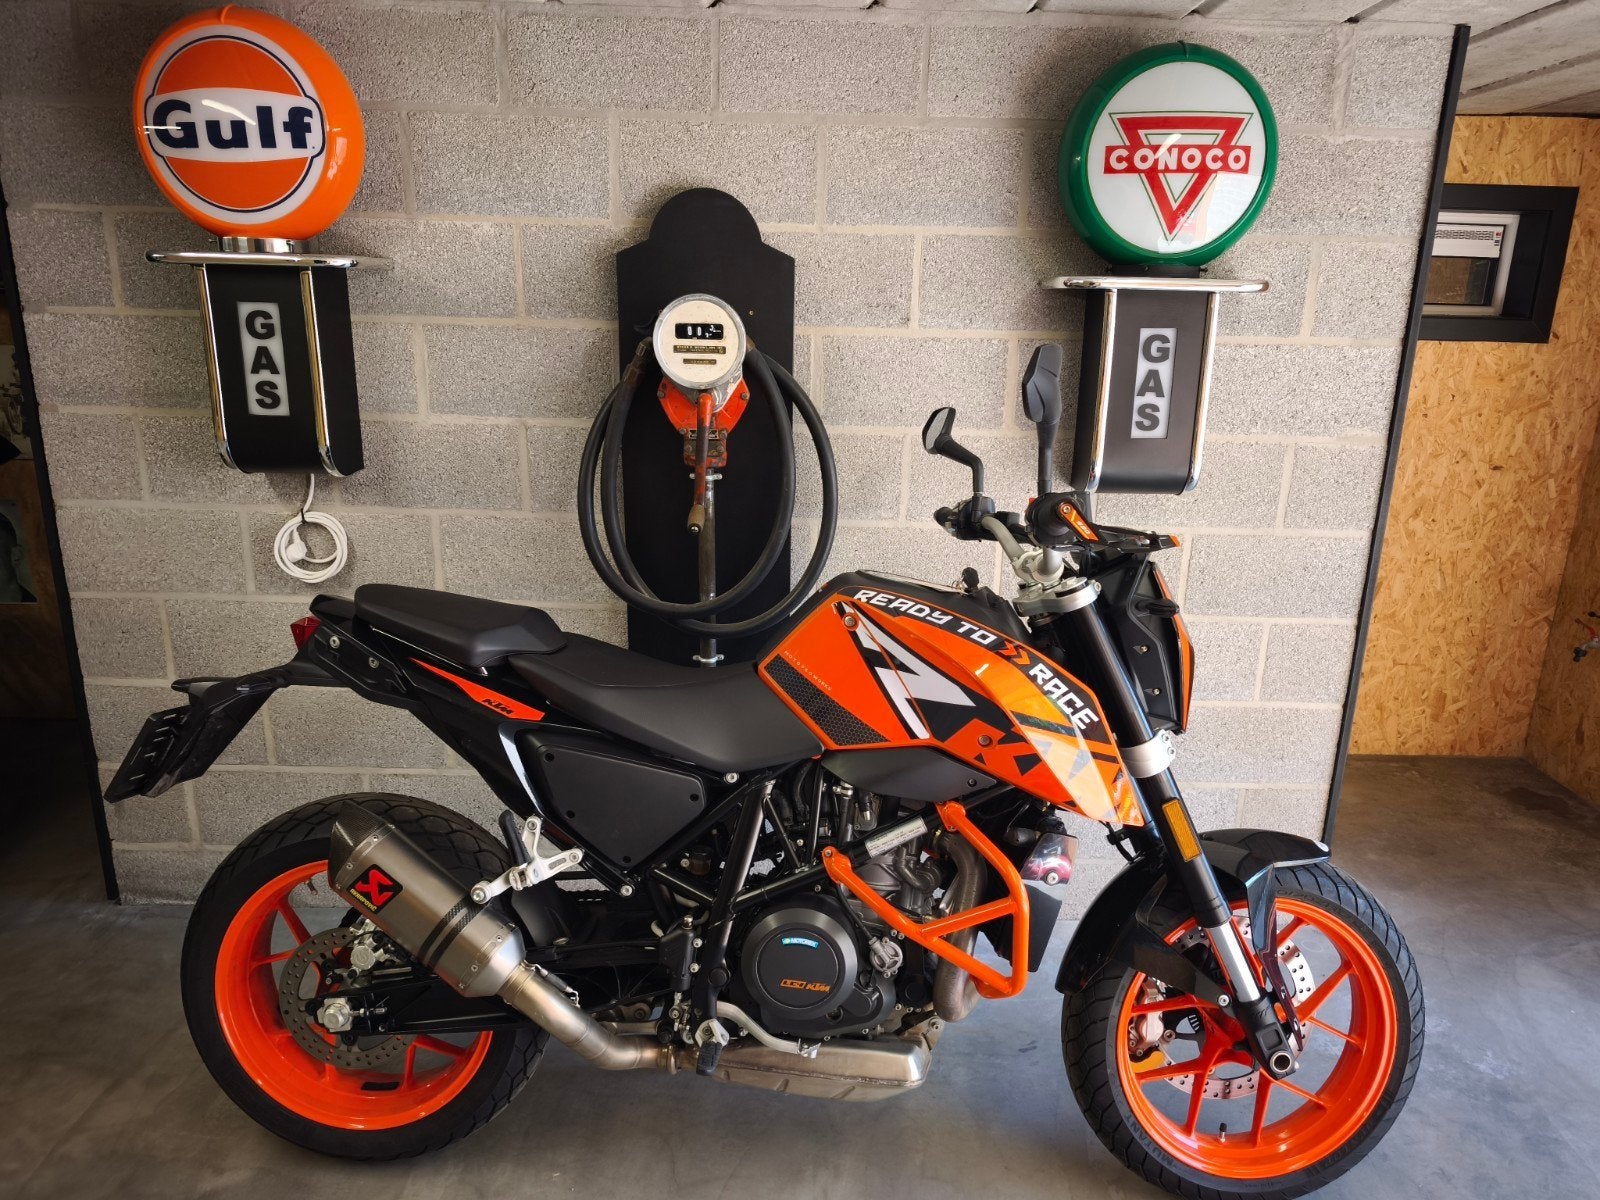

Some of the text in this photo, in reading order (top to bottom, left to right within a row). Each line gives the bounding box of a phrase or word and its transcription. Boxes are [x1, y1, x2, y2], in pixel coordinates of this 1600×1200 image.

[153, 99, 314, 149] Gulf
[1109, 147, 1247, 171] CONOCO
[245, 310, 281, 410] GAS
[1135, 334, 1171, 432] GAS
[853, 589, 1099, 730] READY TO RACE
